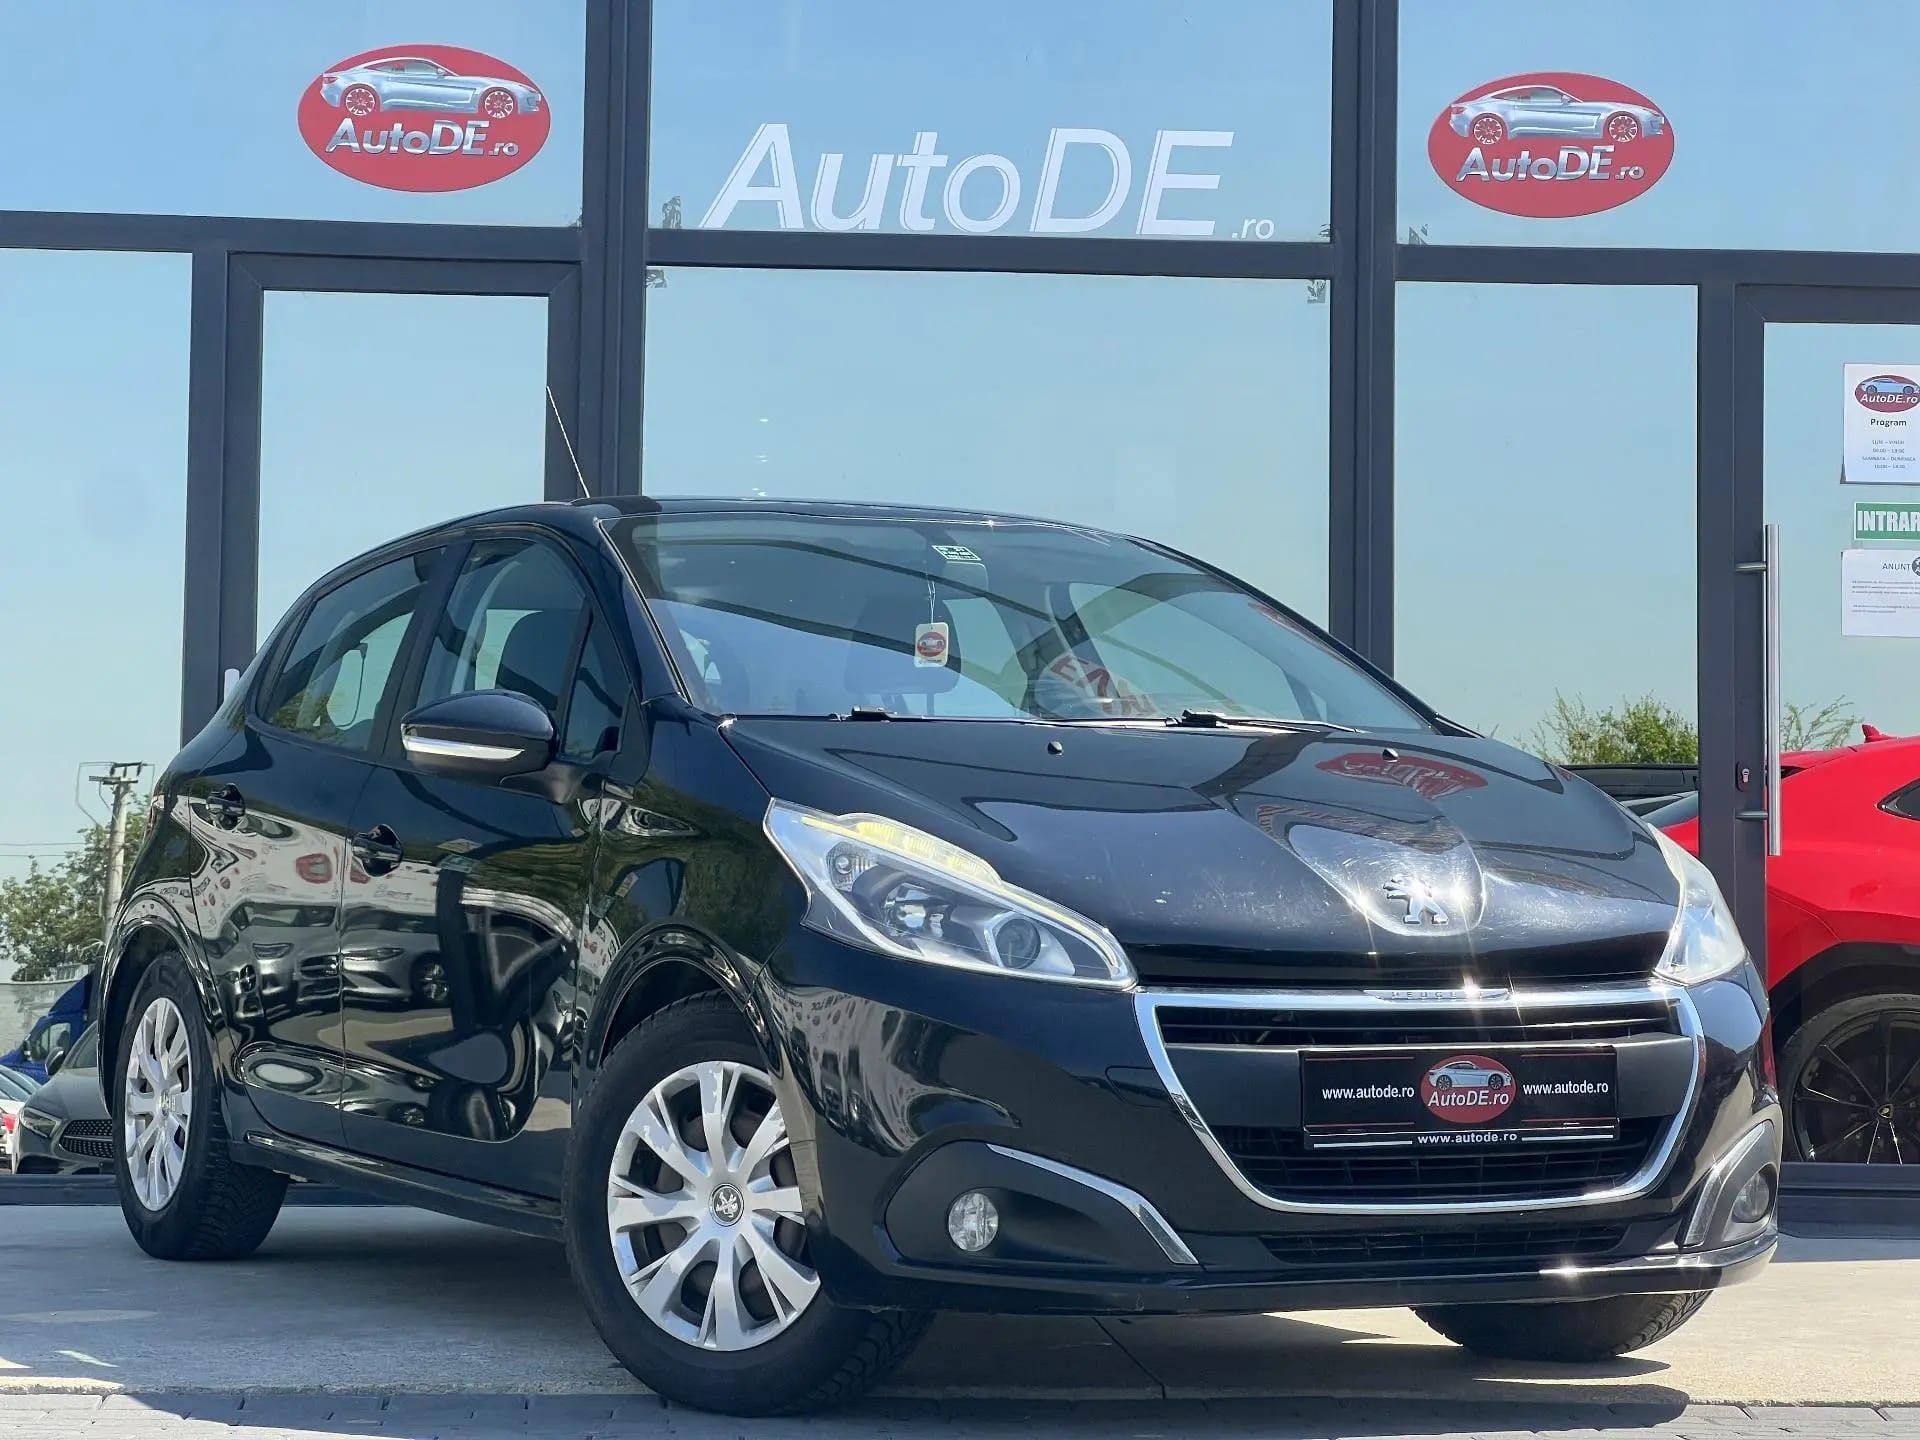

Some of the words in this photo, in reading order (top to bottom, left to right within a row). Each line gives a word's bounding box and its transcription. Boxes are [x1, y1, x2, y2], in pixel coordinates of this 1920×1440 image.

[1870, 418, 1907, 427] Program
[1322, 1085, 1415, 1100] www.autode.ro
[1522, 1081, 1609, 1096] www.autode.ro
[1427, 1089, 1509, 1107] AutoDE.ro
[1417, 1131, 1518, 1144] www.autode.ro
